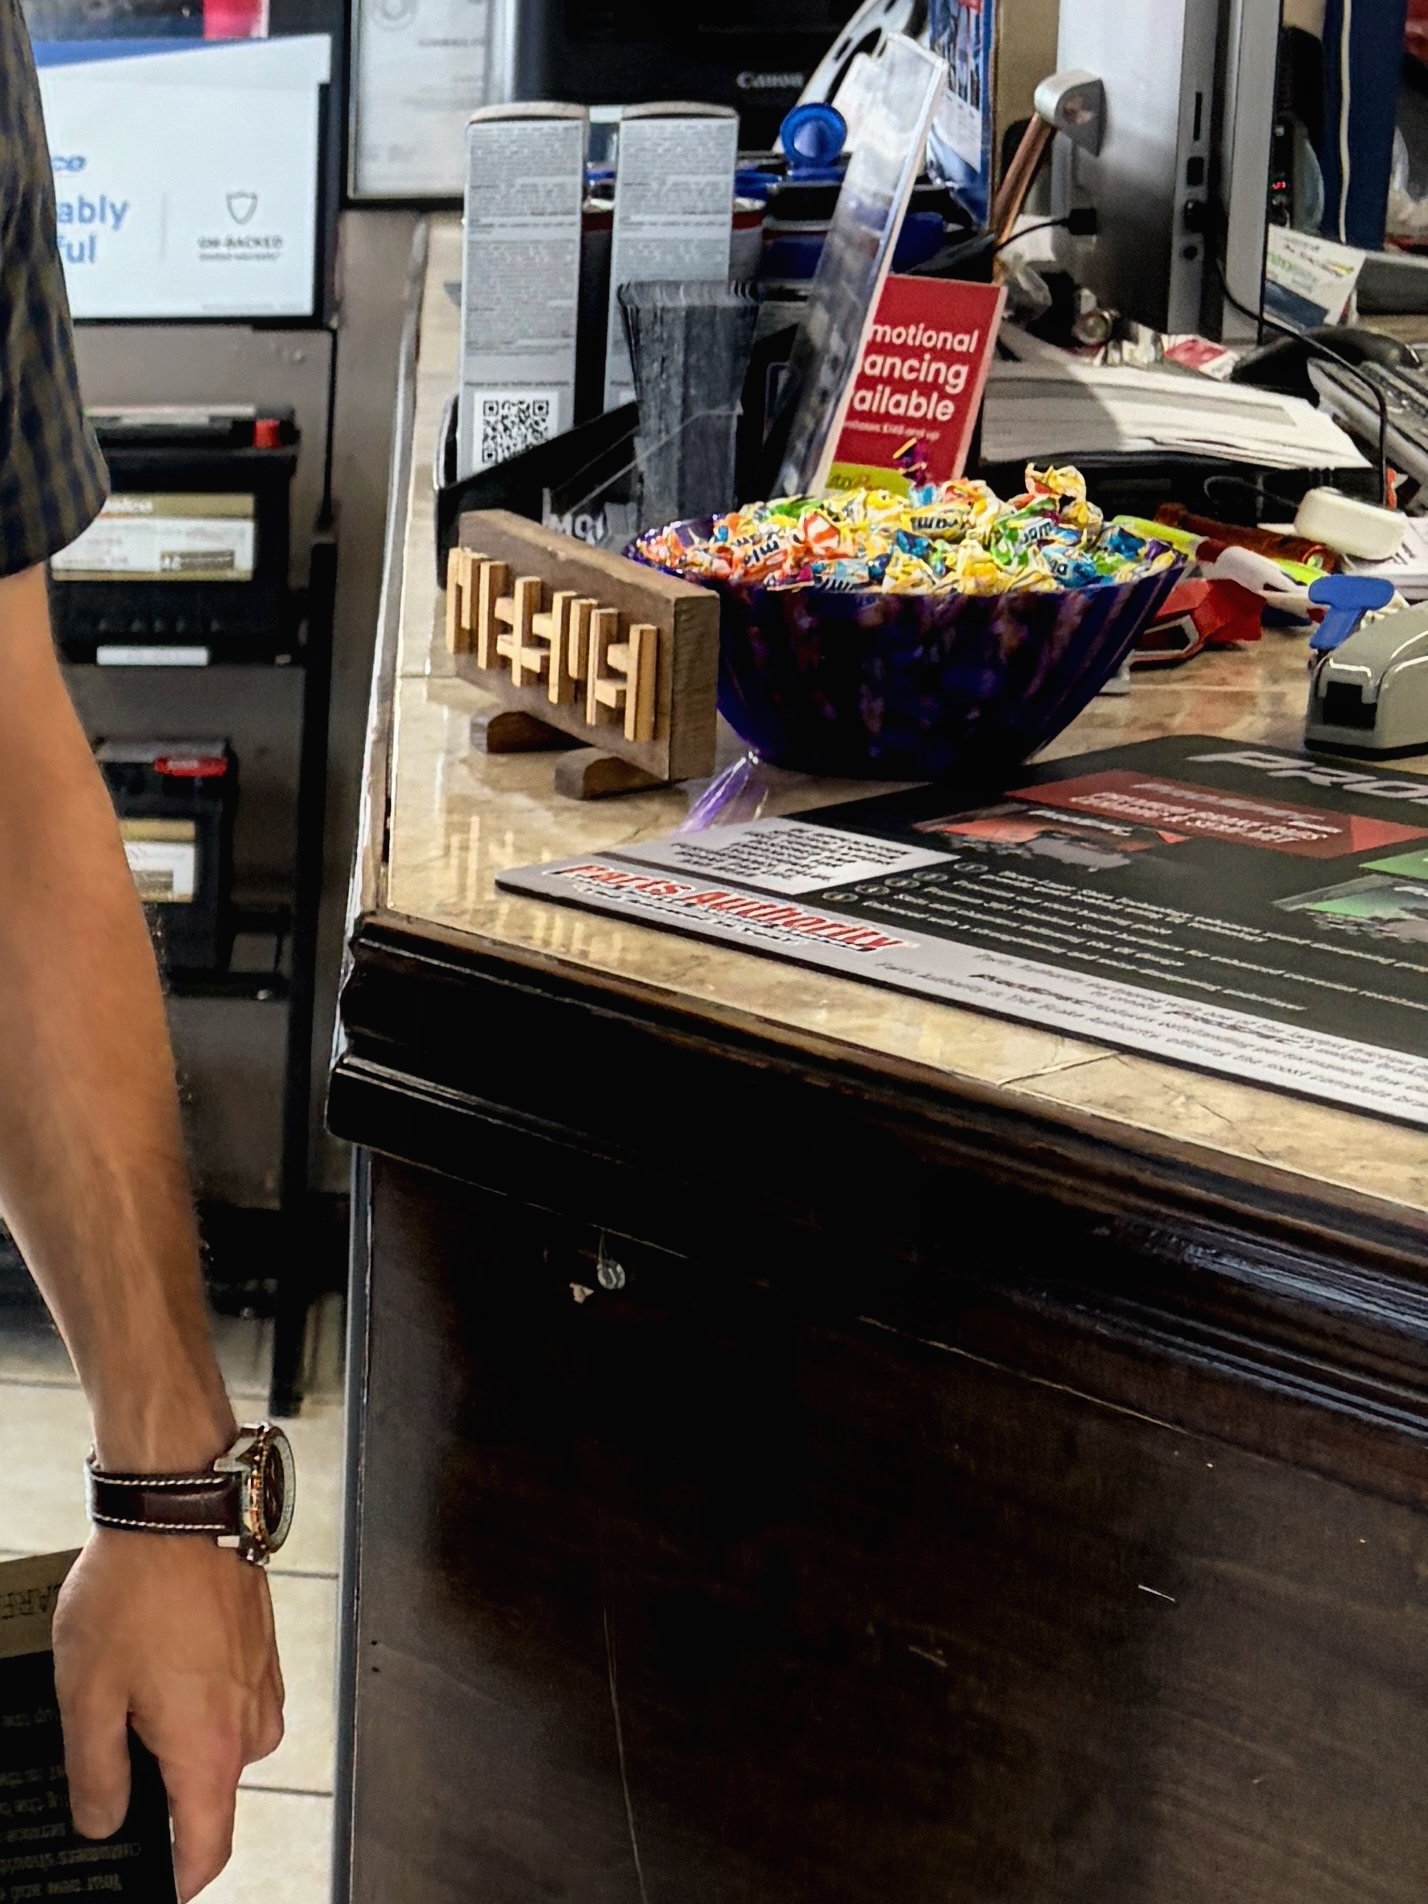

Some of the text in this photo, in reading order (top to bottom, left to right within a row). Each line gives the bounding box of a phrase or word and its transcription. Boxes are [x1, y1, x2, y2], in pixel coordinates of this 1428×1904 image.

[736, 71, 805, 89] Canon
[56, 195, 130, 230] ably
[868, 322, 979, 354] motional
[858, 353, 970, 395] ancing
[851, 384, 955, 422] ailable
[1184, 751, 1428, 806] PRO
